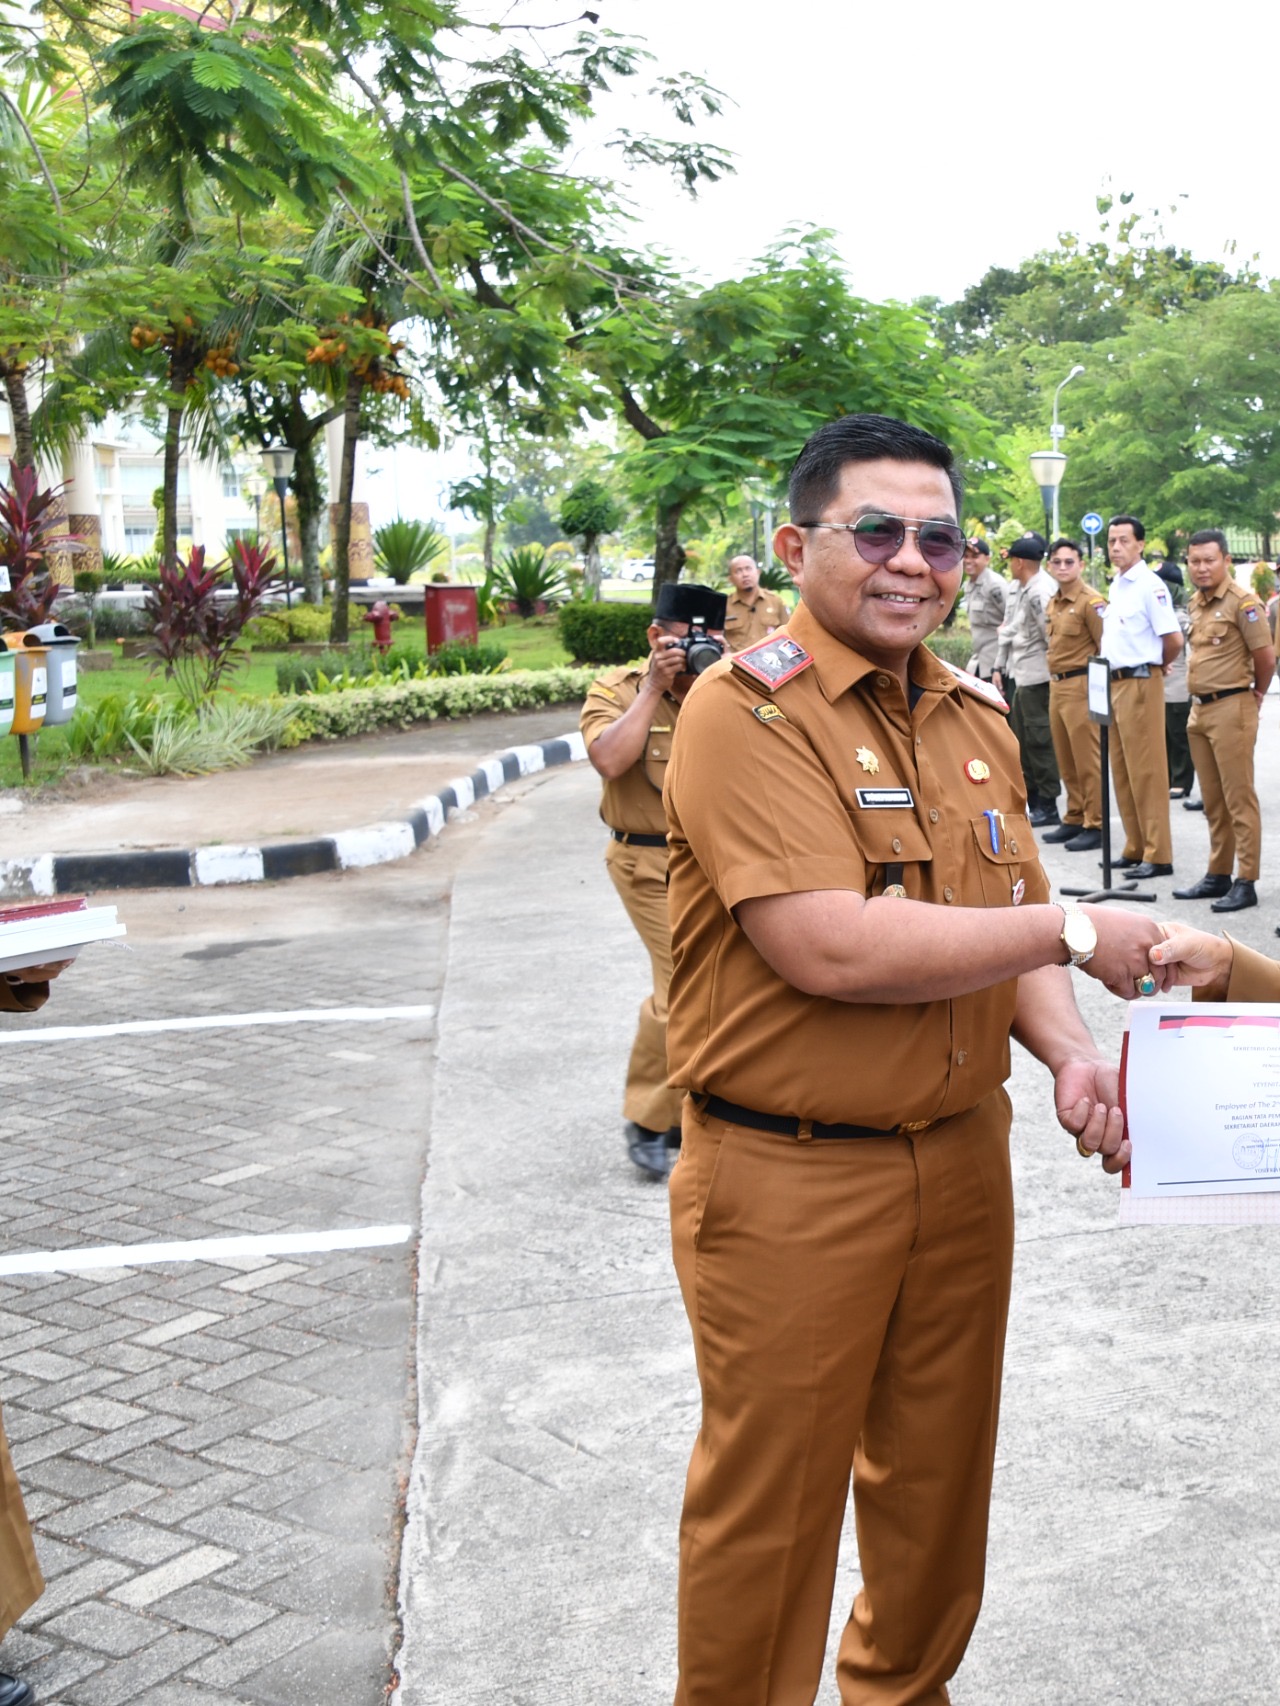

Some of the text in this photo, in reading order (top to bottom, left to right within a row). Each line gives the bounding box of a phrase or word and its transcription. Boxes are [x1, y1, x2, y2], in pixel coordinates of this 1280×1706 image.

[1215, 1102, 1247, 1111] Employee
[1249, 1101, 1256, 1109] of
[1258, 1101, 1271, 1109] The
[1224, 1122, 1258, 1130] SEKRETARIAT
